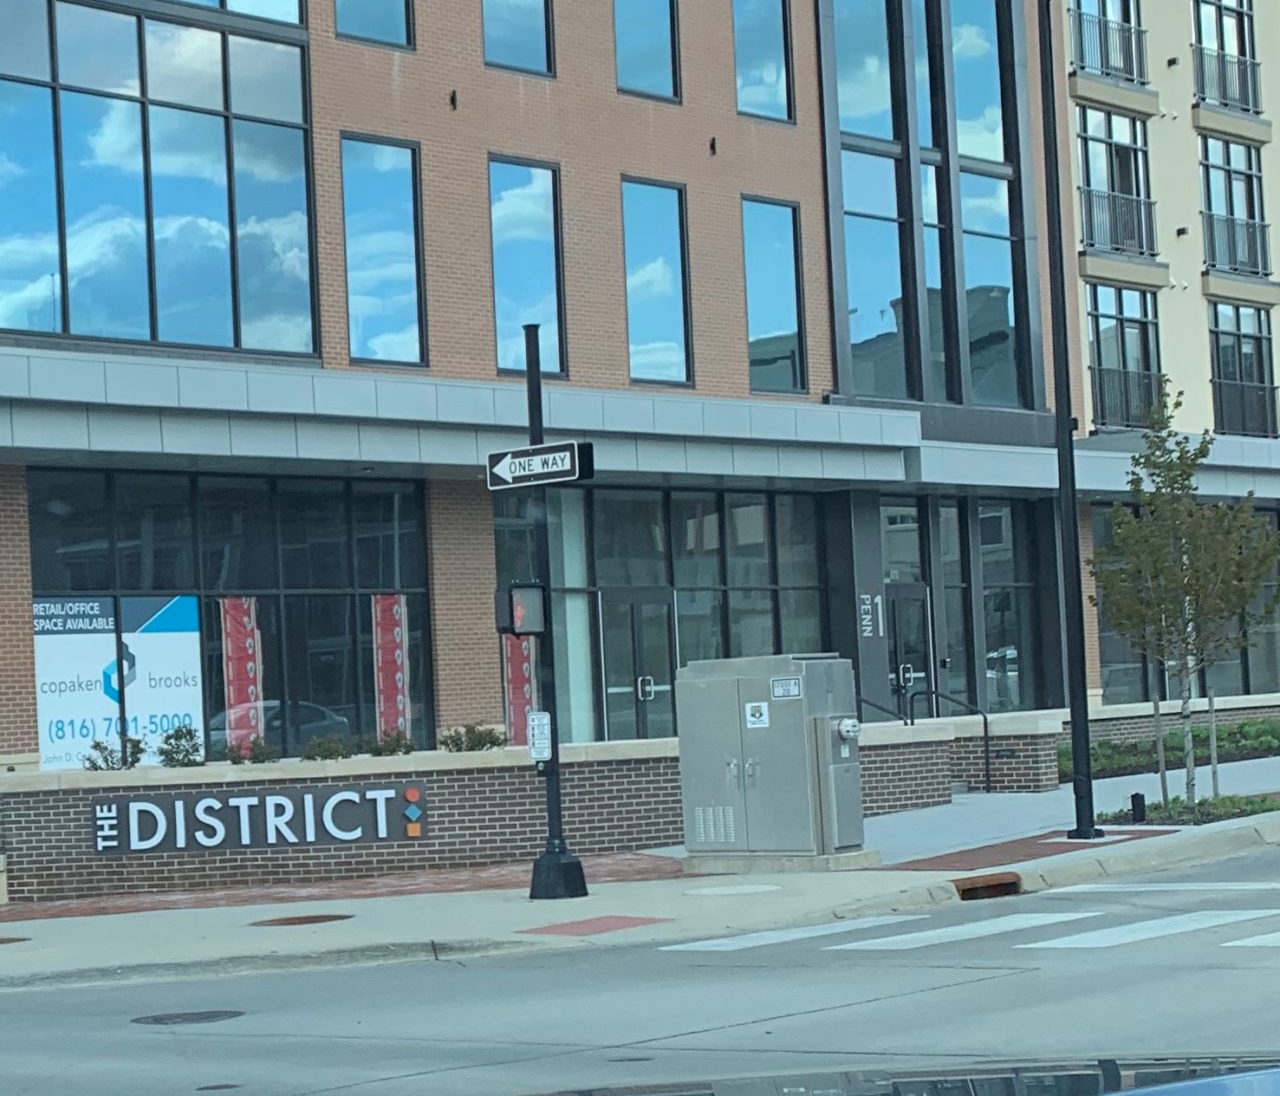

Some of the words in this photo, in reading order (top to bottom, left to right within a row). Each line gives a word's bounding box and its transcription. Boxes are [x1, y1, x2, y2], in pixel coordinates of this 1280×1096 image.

[508, 458, 535, 474] ONE
[540, 454, 567, 470] WAY
[32, 602, 100, 616] RETAIL/OFFICE
[860, 594, 873, 637] PENN
[874, 594, 884, 637] 1
[33, 618, 64, 631] SPACE
[65, 617, 115, 630] AVAILABLE
[40, 674, 103, 697] copaken
[148, 672, 198, 688] brooks
[48, 718, 96, 743] (816)
[96, 802, 119, 851] THE
[128, 789, 396, 851] DISTRICT
